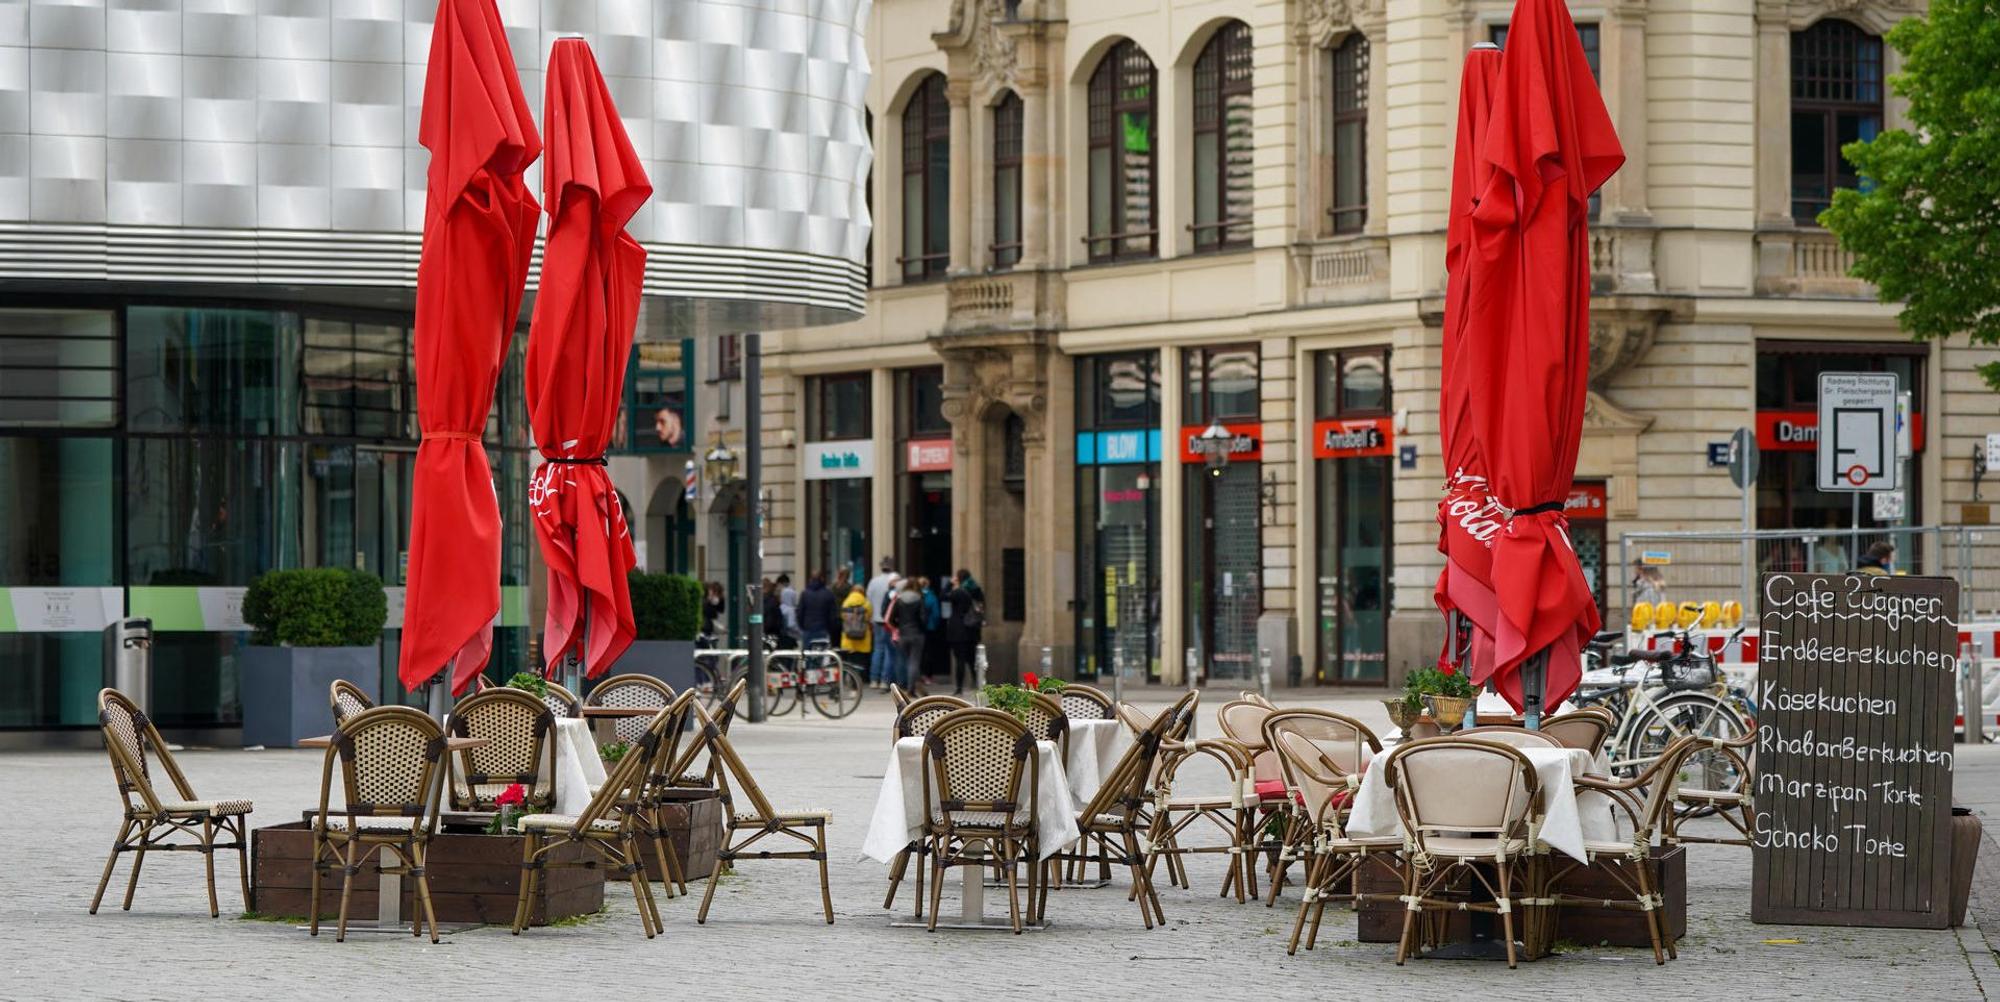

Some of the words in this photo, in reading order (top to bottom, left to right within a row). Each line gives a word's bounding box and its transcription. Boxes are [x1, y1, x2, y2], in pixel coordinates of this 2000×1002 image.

[1858, 377, 1890, 388] Richtung
[1106, 434, 1138, 459] BLOW
[1766, 575, 1835, 623] Cafe
[1845, 576, 1943, 631] Wagner
[1873, 781, 1923, 807] Torte
[1754, 813, 1839, 852] Schoko
[1844, 825, 1907, 857] Torte
